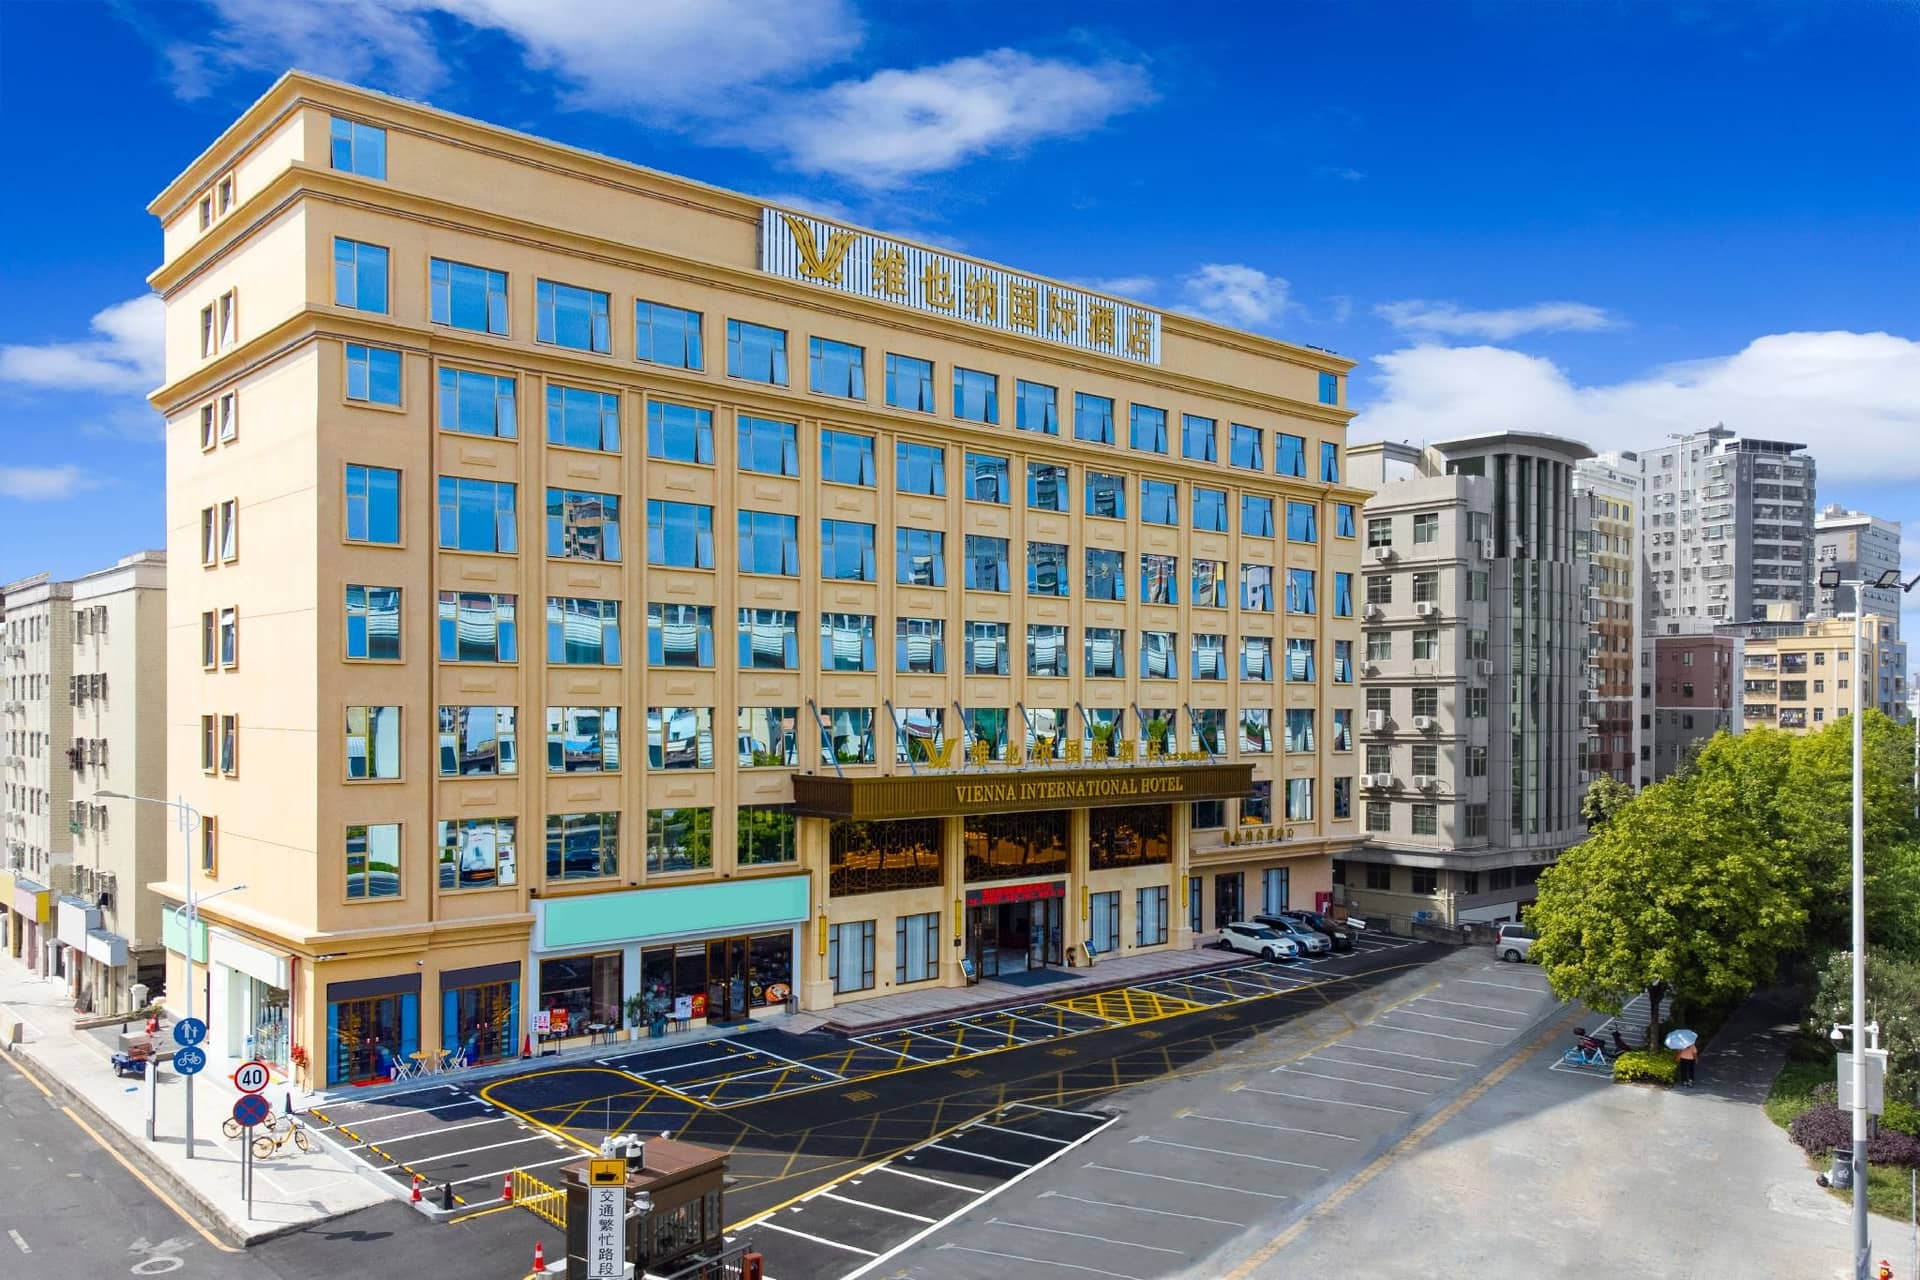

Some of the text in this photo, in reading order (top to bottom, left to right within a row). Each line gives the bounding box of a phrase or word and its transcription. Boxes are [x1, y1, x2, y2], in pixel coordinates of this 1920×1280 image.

[871, 246, 1152, 358] 维也纳国际酒店
[955, 776, 1184, 803] VIENNA INTERNATIONAL HOTEL
[242, 1069, 263, 1086] 40
[598, 1188, 615, 1276] 交通繁忙路段
